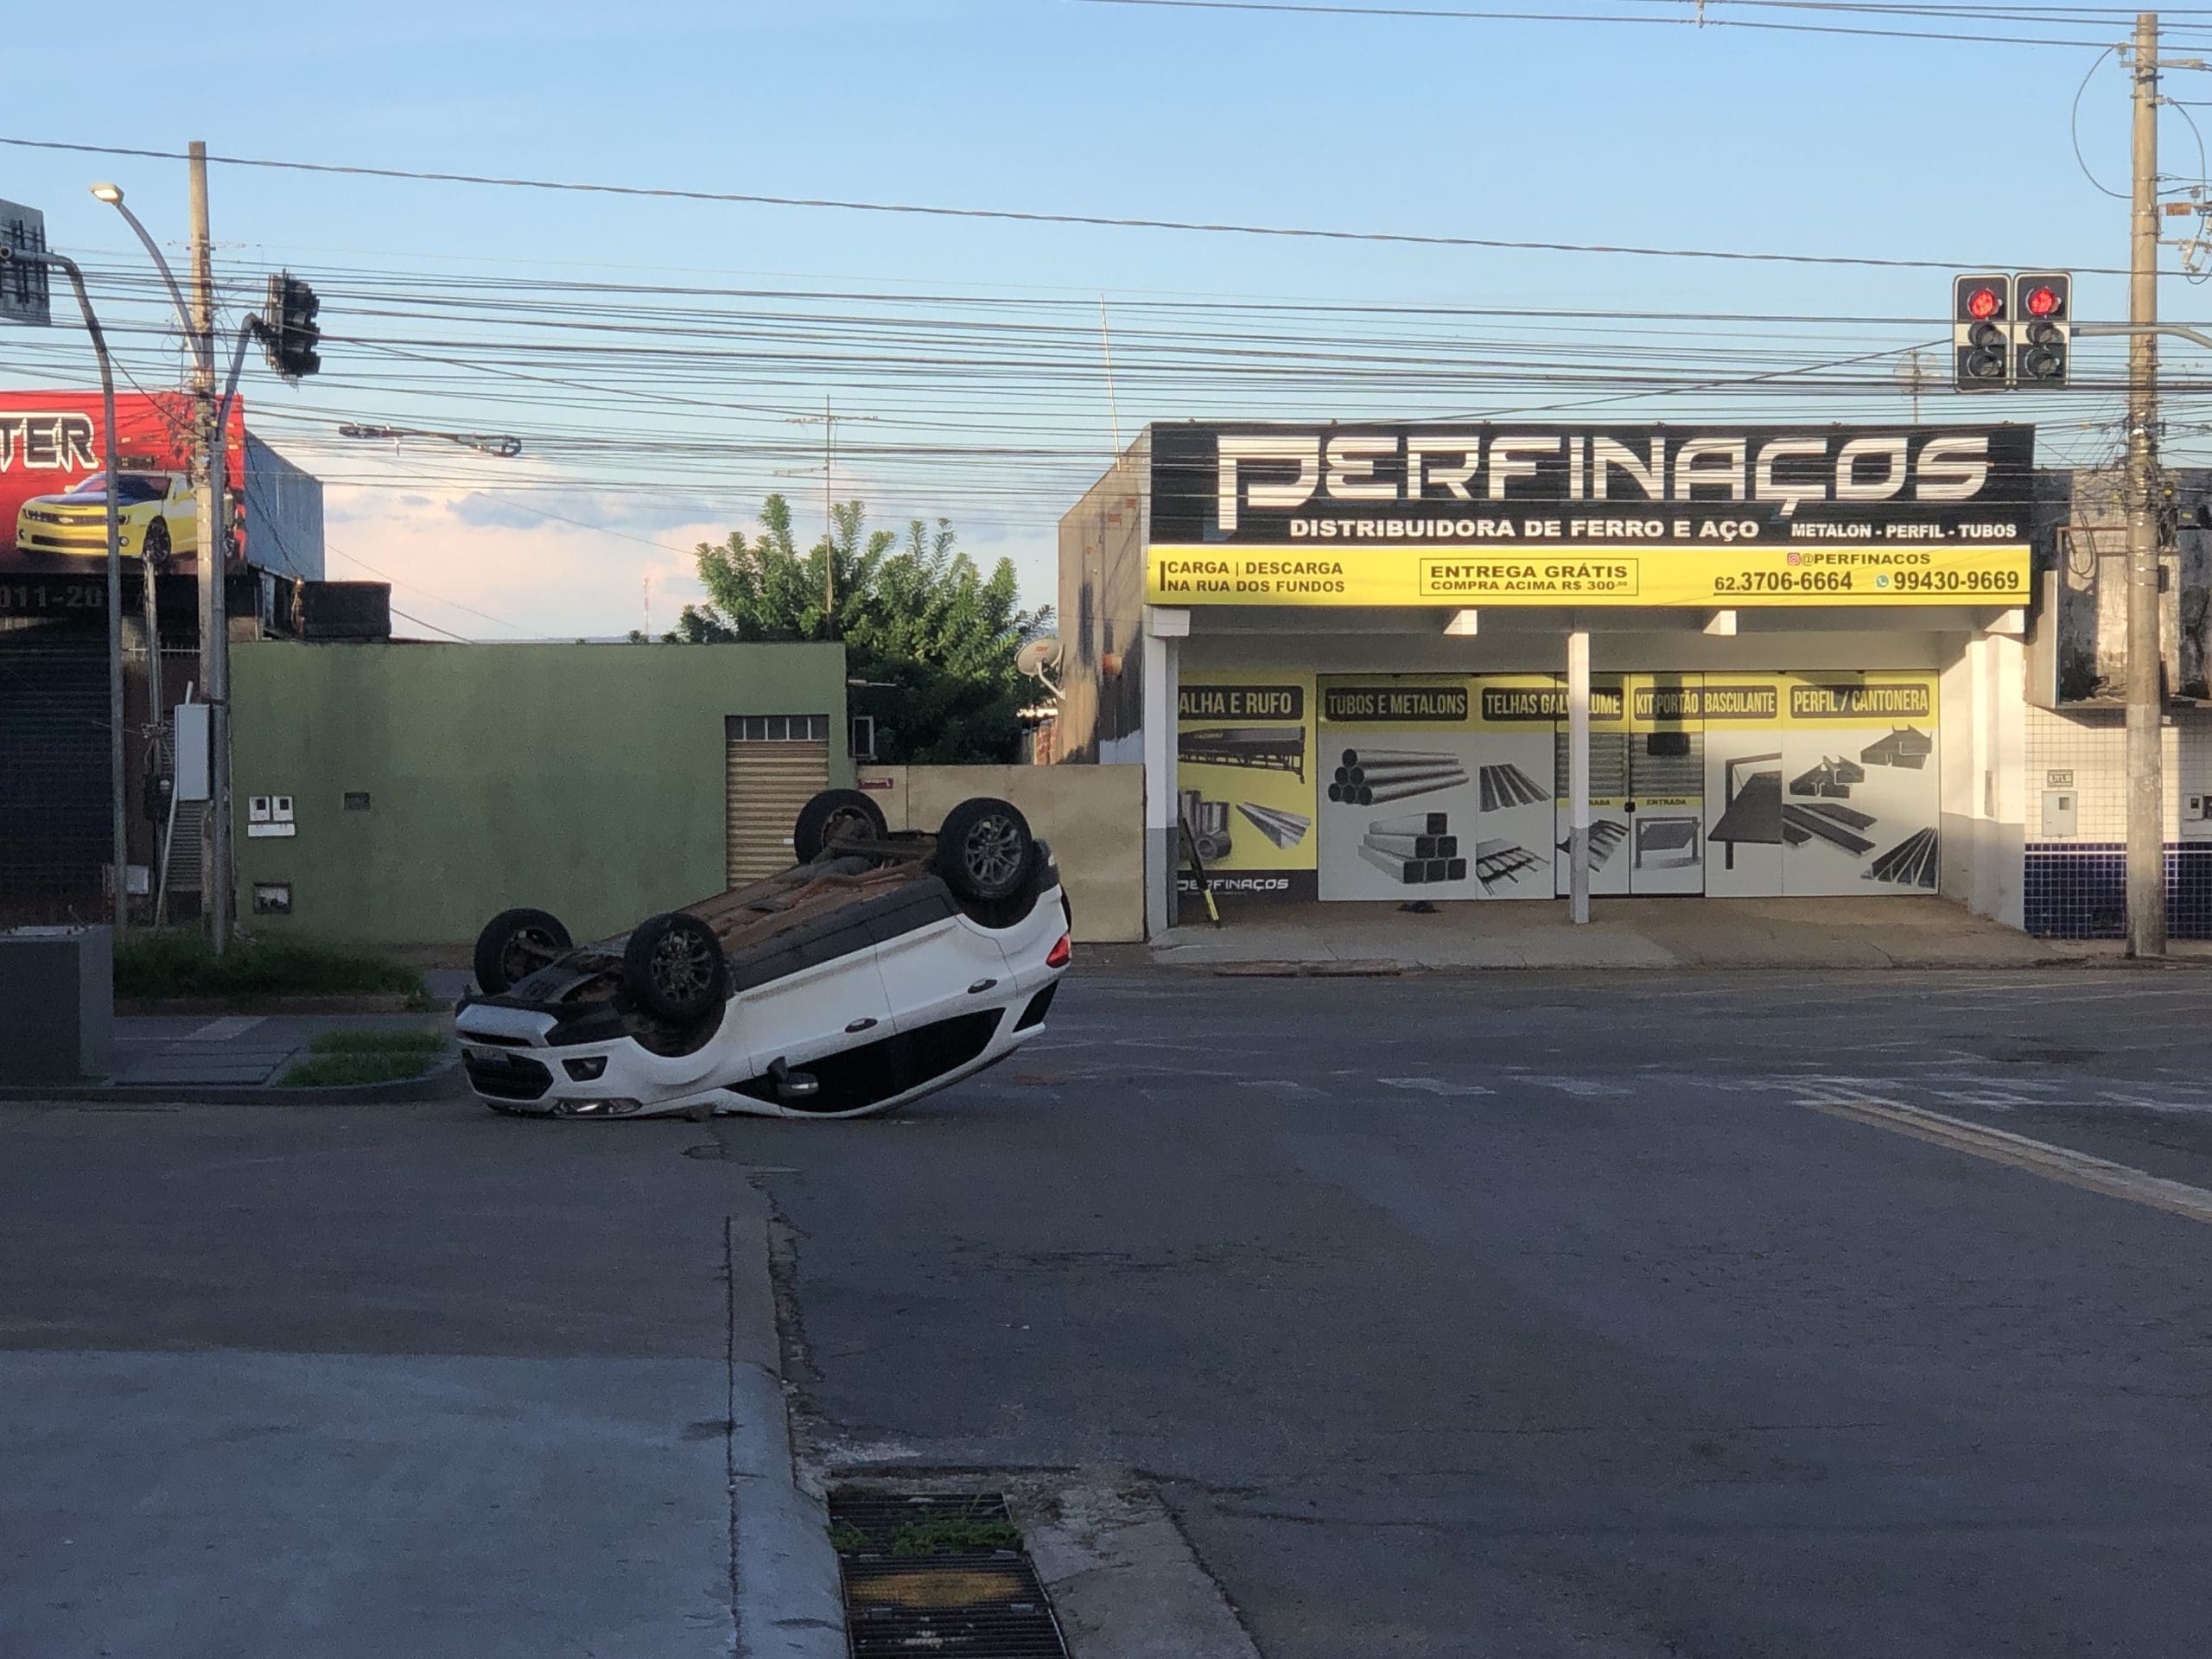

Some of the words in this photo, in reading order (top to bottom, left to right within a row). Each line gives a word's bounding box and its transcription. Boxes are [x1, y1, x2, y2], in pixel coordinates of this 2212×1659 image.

[1217, 435, 1989, 531] PERFINAÇOS
[1290, 519, 1516, 537] DISTRIBUIDORA
[1524, 520, 1561, 537] DE
[1571, 520, 1664, 537] FERRO
[1674, 520, 1691, 537] E
[1699, 520, 1759, 542] AÇO
[1791, 524, 1872, 537] METALON
[1886, 525, 1944, 537] PERFIL
[1958, 525, 2017, 537] TUBOS
[1167, 562, 1230, 574] CARGA
[1246, 562, 1344, 575] DESCARGA
[1802, 554, 1930, 566] @PERFINACOS
[1431, 566, 1536, 578] ENTREGA
[1544, 563, 1628, 578] GRÁTIS
[1893, 570, 2019, 590] 99430-9669
[1167, 580, 1191, 591] NA
[1197, 581, 1230, 592] RUA
[1236, 581, 1270, 592] DOS
[1276, 581, 1344, 593] FUNDOS
[1431, 581, 1499, 590] COMPRA
[1504, 581, 1556, 590] ACIMA
[1561, 581, 1581, 591] R$
[1714, 572, 1853, 591] 62.3706-6664
[1230, 692, 1241, 714] E
[1246, 692, 1292, 714] RUFO
[1328, 695, 1374, 715] TUBOS
[1378, 695, 1387, 715] E
[1390, 694, 1466, 715] METALONS
[1486, 695, 1538, 714] TELHAS
[1636, 694, 1654, 714] KIT
[1656, 690, 1699, 714] PORTÃO
[1704, 692, 1776, 713] BASCULANTE
[1794, 691, 1838, 712] PERFIL
[1852, 690, 1928, 711] CANTONERA
